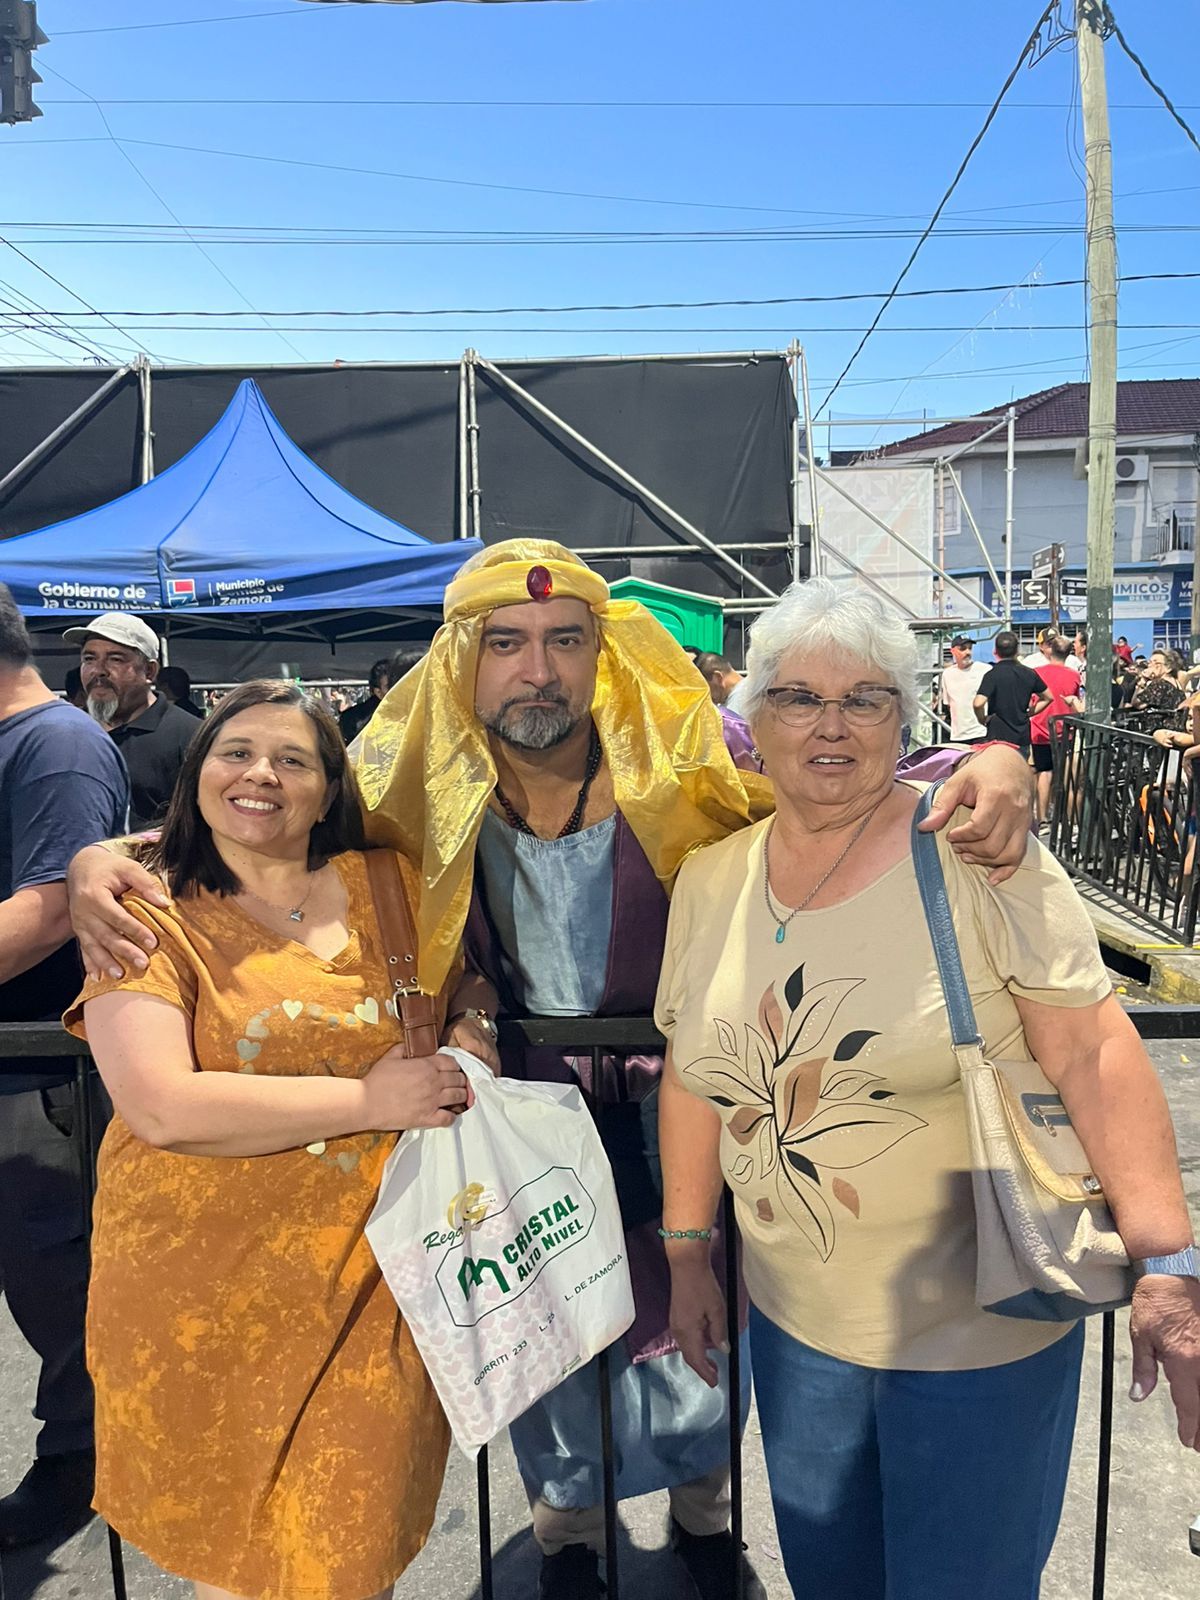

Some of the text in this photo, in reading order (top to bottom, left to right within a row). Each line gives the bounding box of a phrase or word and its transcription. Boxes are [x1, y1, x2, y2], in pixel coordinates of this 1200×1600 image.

[38, 582, 146, 599] Gobierno de
[216, 578, 265, 591] Municipio
[1114, 583, 1169, 594] IMICOS
[219, 595, 273, 606] Zamora
[503, 1194, 579, 1264] CRISTAL
[423, 1226, 464, 1254] Rega
[473, 1353, 510, 1386] GORRITI
[512, 1340, 528, 1356] 233
[574, 1281, 588, 1294] DE
[588, 1254, 623, 1284] ZAMORA
